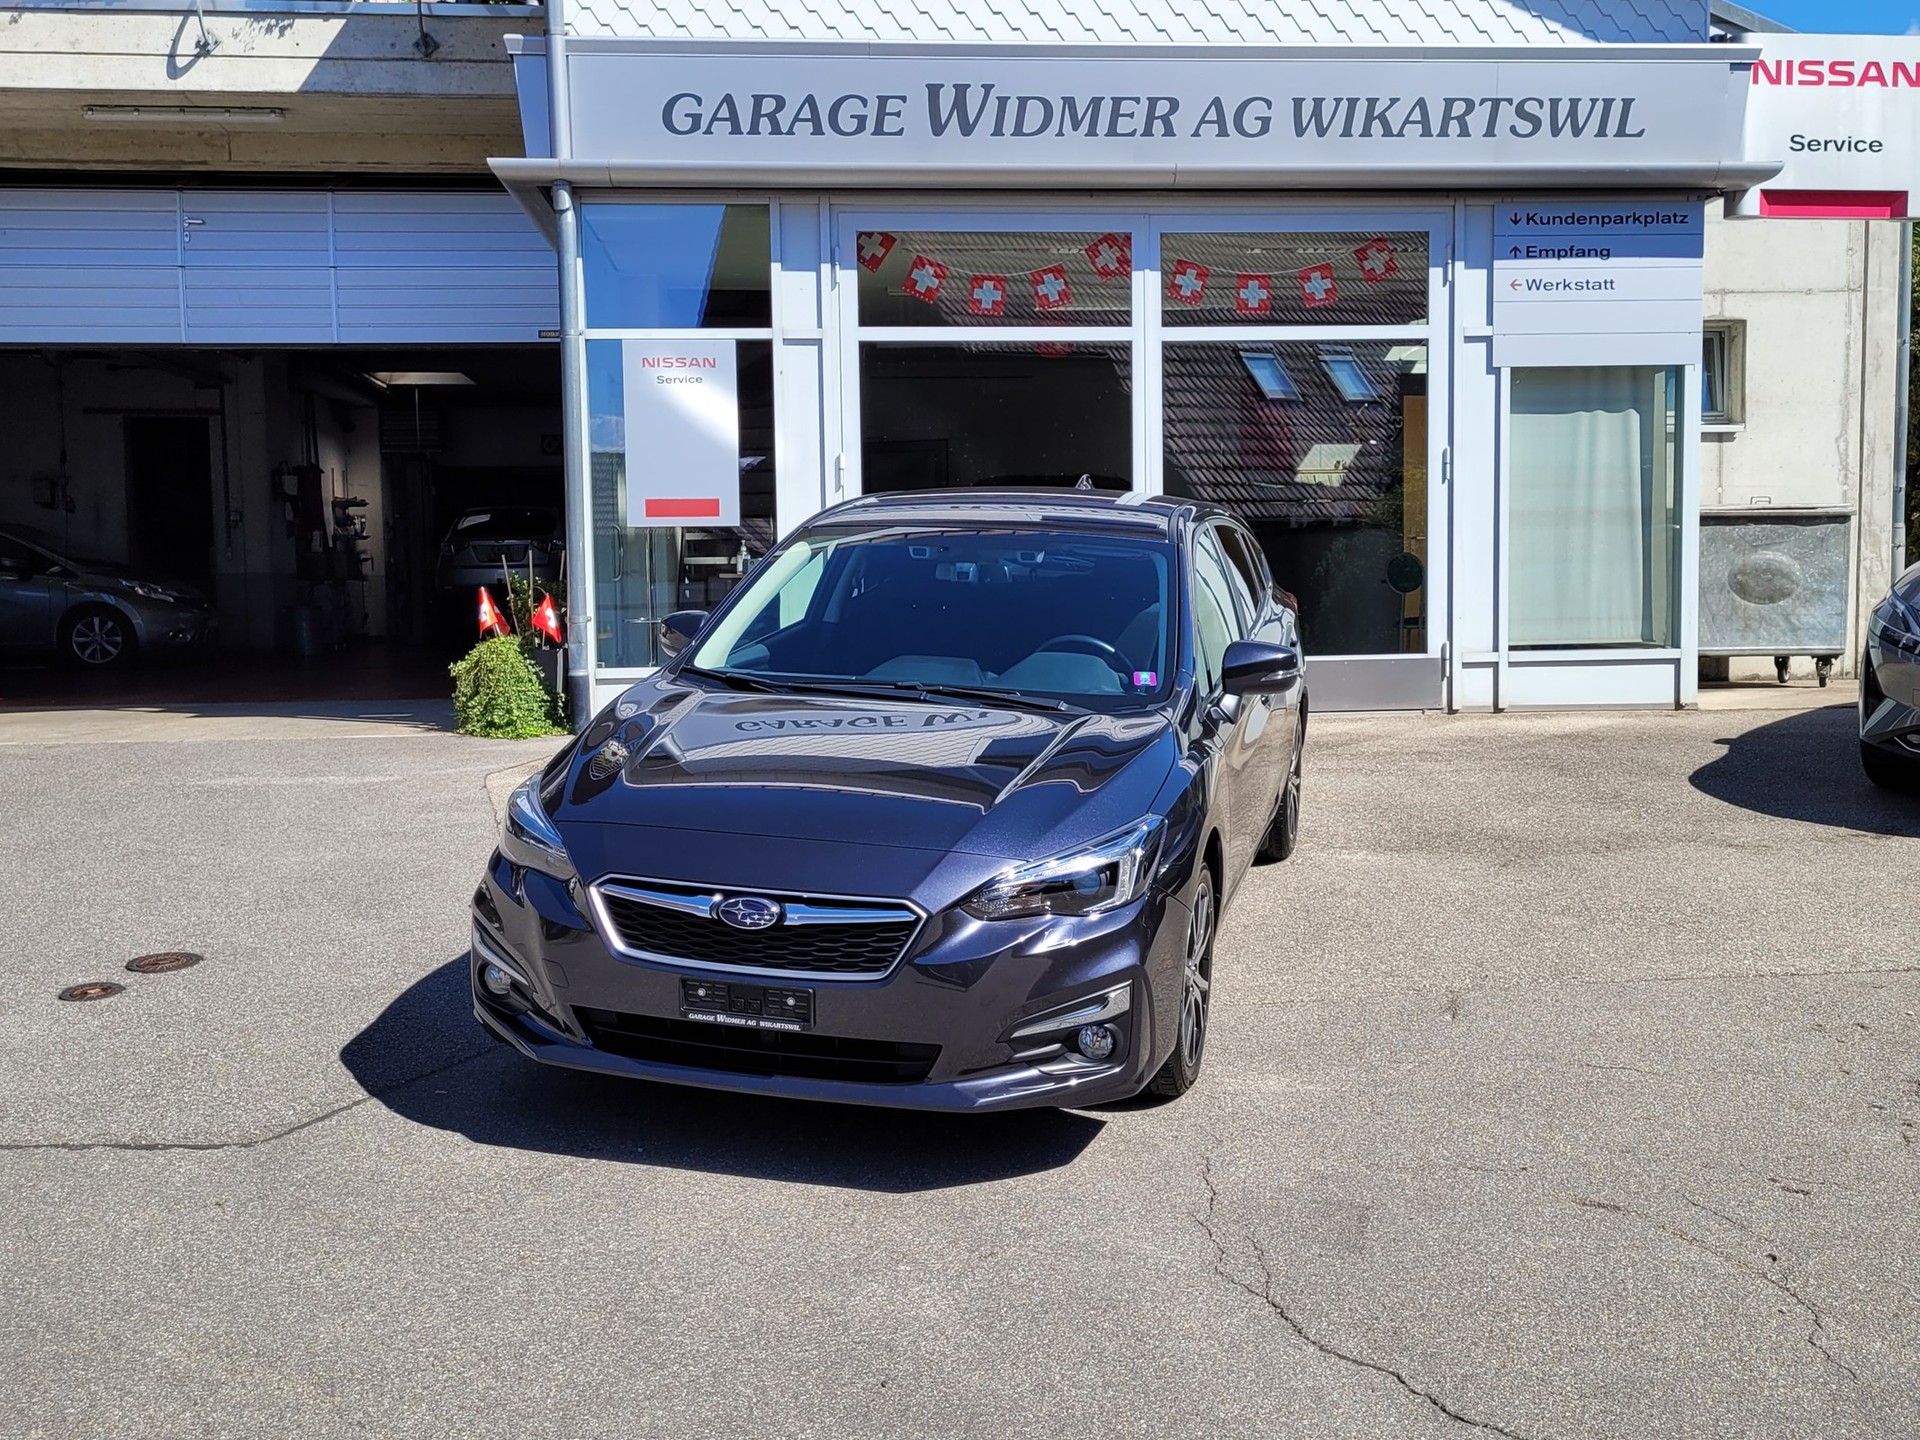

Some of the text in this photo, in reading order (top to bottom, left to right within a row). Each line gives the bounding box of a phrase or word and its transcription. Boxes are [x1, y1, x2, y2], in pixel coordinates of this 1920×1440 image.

[1752, 59, 1920, 88] NISSAN
[661, 83, 1646, 138] GARAGE WIDMER AG WIKARTSWIL
[1789, 134, 1883, 153] Service
[1525, 211, 1689, 228] Kundenparkplatz
[1525, 245, 1611, 261] Empfang
[1525, 278, 1615, 291] Werkstatt
[641, 357, 717, 369] NISSAN
[656, 375, 703, 385] Service
[688, 1012, 716, 1022] GARAGE
[716, 1014, 746, 1025] WIDMER
[759, 1020, 801, 1031] WIKARTSWIL
